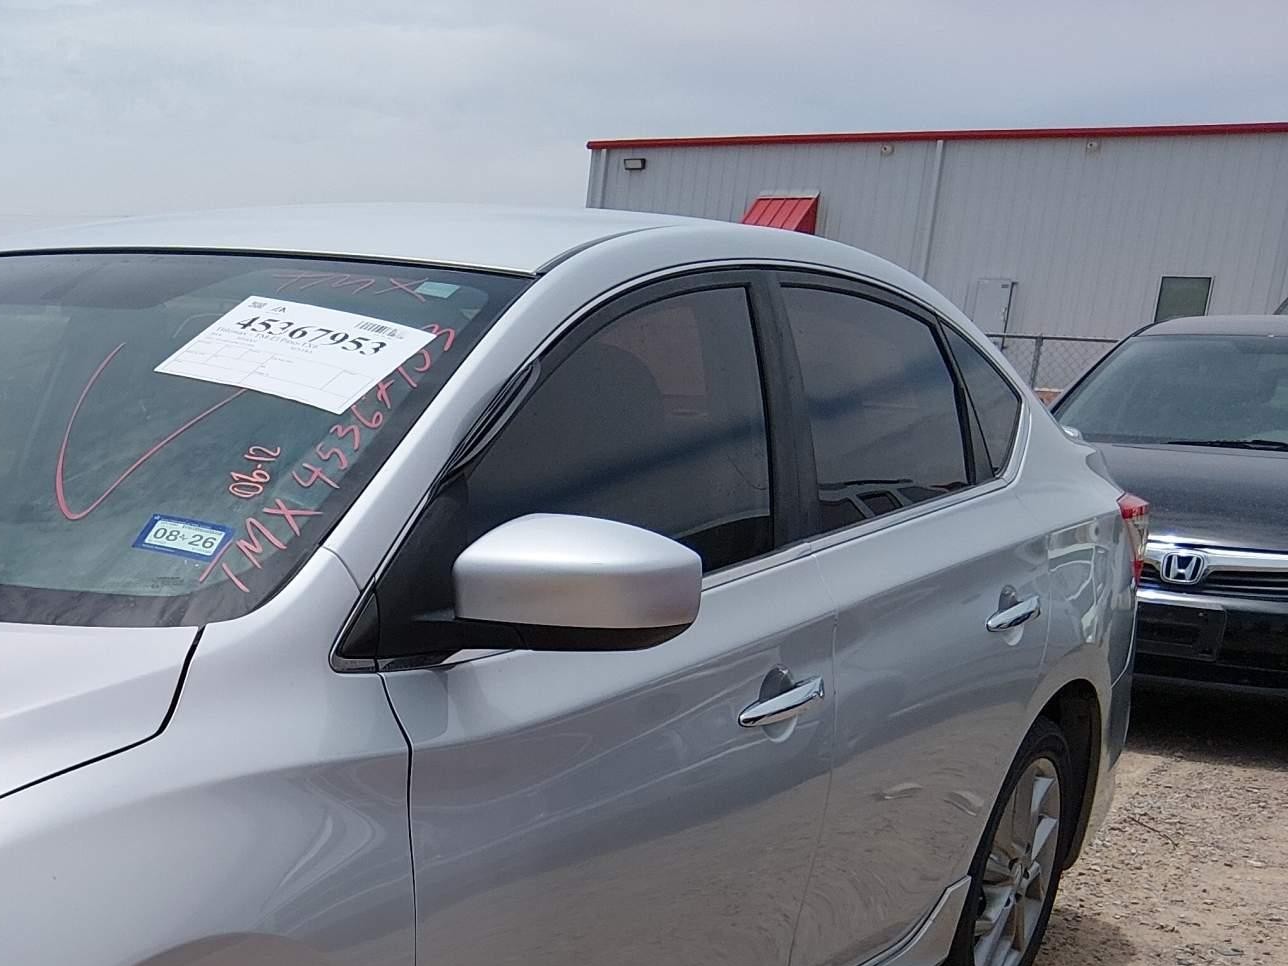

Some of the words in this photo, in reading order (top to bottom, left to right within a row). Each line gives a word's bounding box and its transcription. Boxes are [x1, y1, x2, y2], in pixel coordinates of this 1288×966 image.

[236, 315, 387, 356] 45367953
[153, 527, 180, 542] 08
[188, 534, 217, 549] 26
